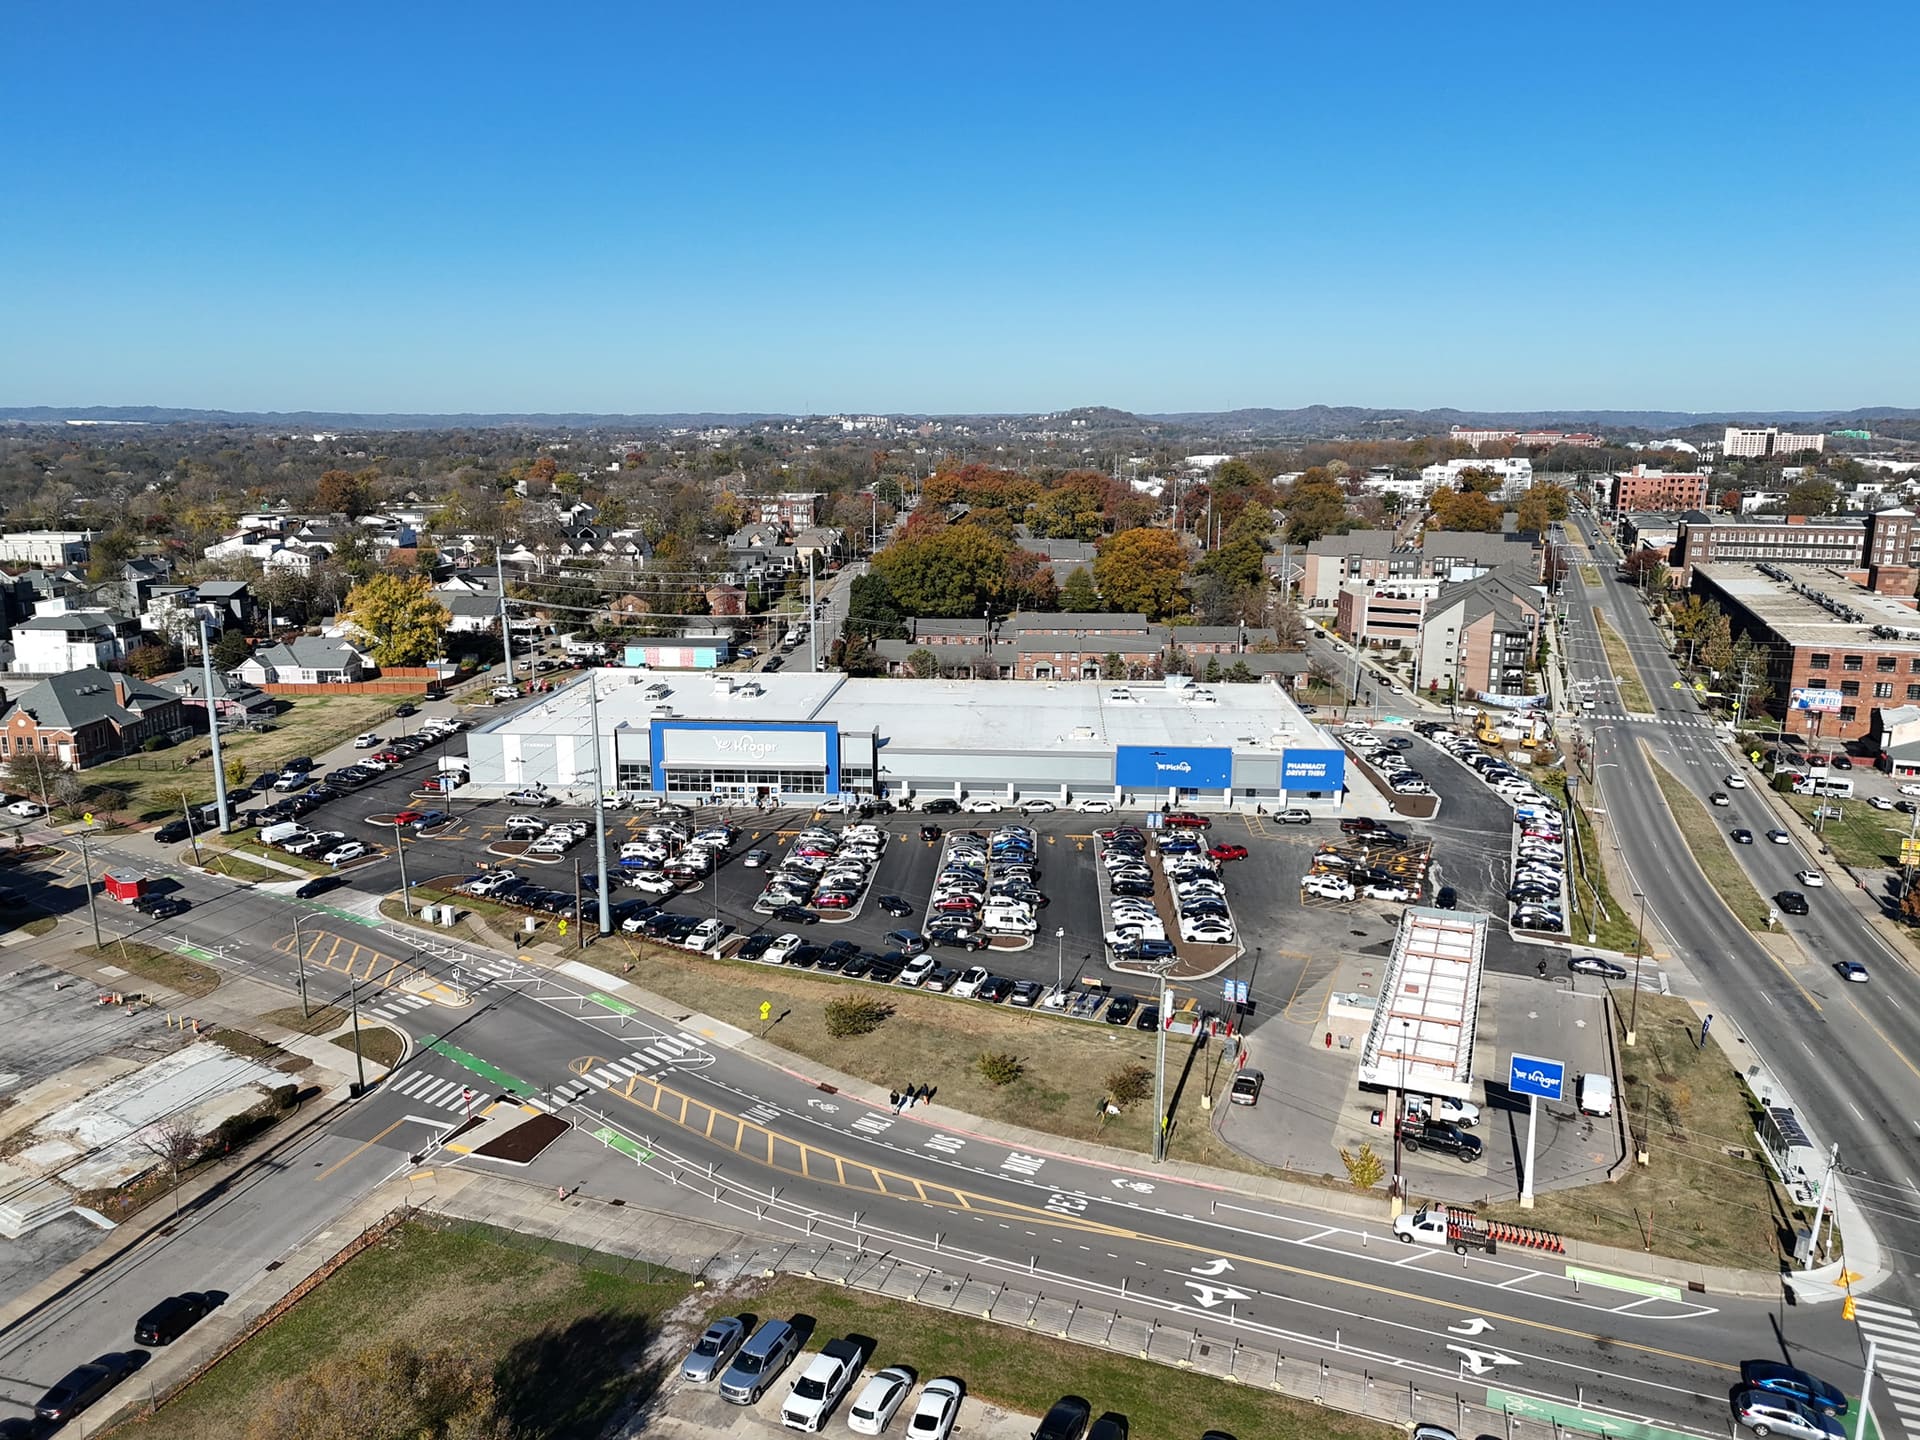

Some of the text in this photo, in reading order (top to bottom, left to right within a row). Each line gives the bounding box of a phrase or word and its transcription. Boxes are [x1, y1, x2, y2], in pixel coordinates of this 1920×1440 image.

[734, 735, 778, 759] Kroger
[1286, 762, 1326, 770] PHARMACY
[1528, 1070, 1560, 1088] Kroger
[851, 1111, 895, 1134] ONLY
[924, 1133, 966, 1154] BUS
[1000, 1151, 1046, 1176] BIKE
[1044, 1193, 1089, 1217] PED
